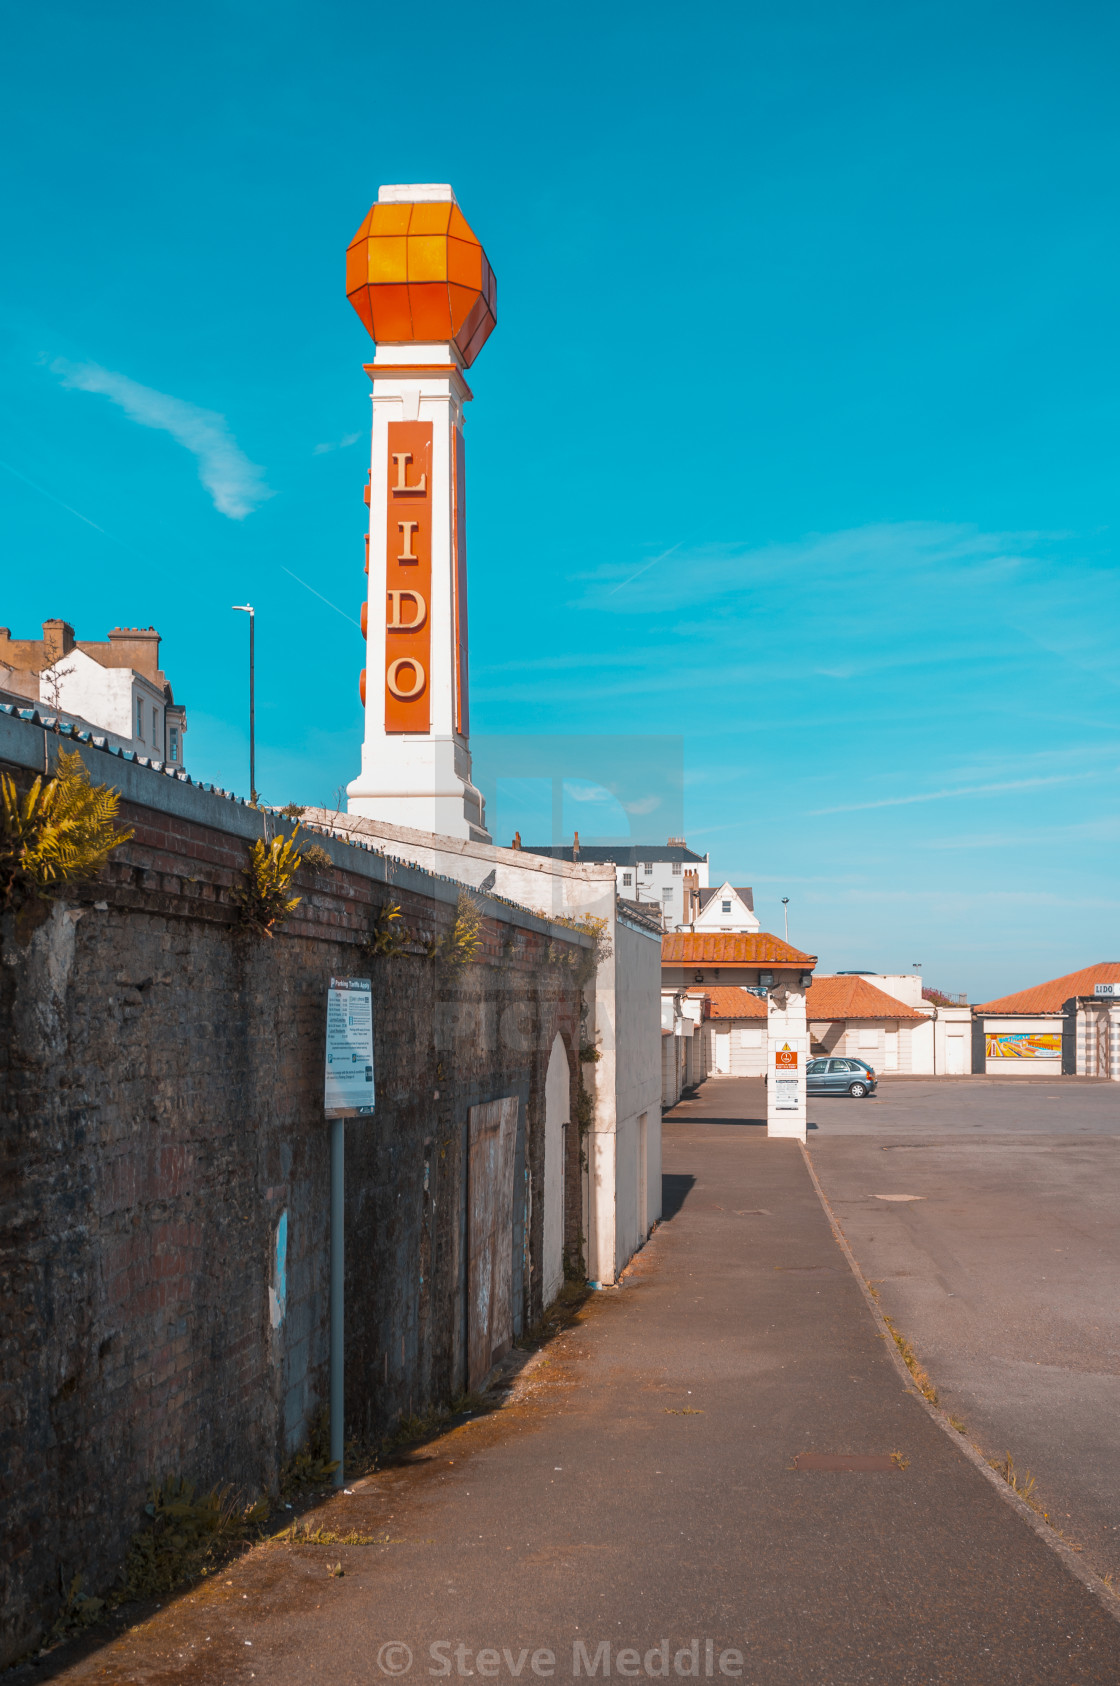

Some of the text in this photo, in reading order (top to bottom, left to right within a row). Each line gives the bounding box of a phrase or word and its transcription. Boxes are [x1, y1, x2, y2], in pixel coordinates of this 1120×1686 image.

[386, 452, 427, 699] LIDO
[335, 979, 349, 989] Parking
[360, 981, 370, 990] Apply
[1096, 985, 1113, 993] LIDO
